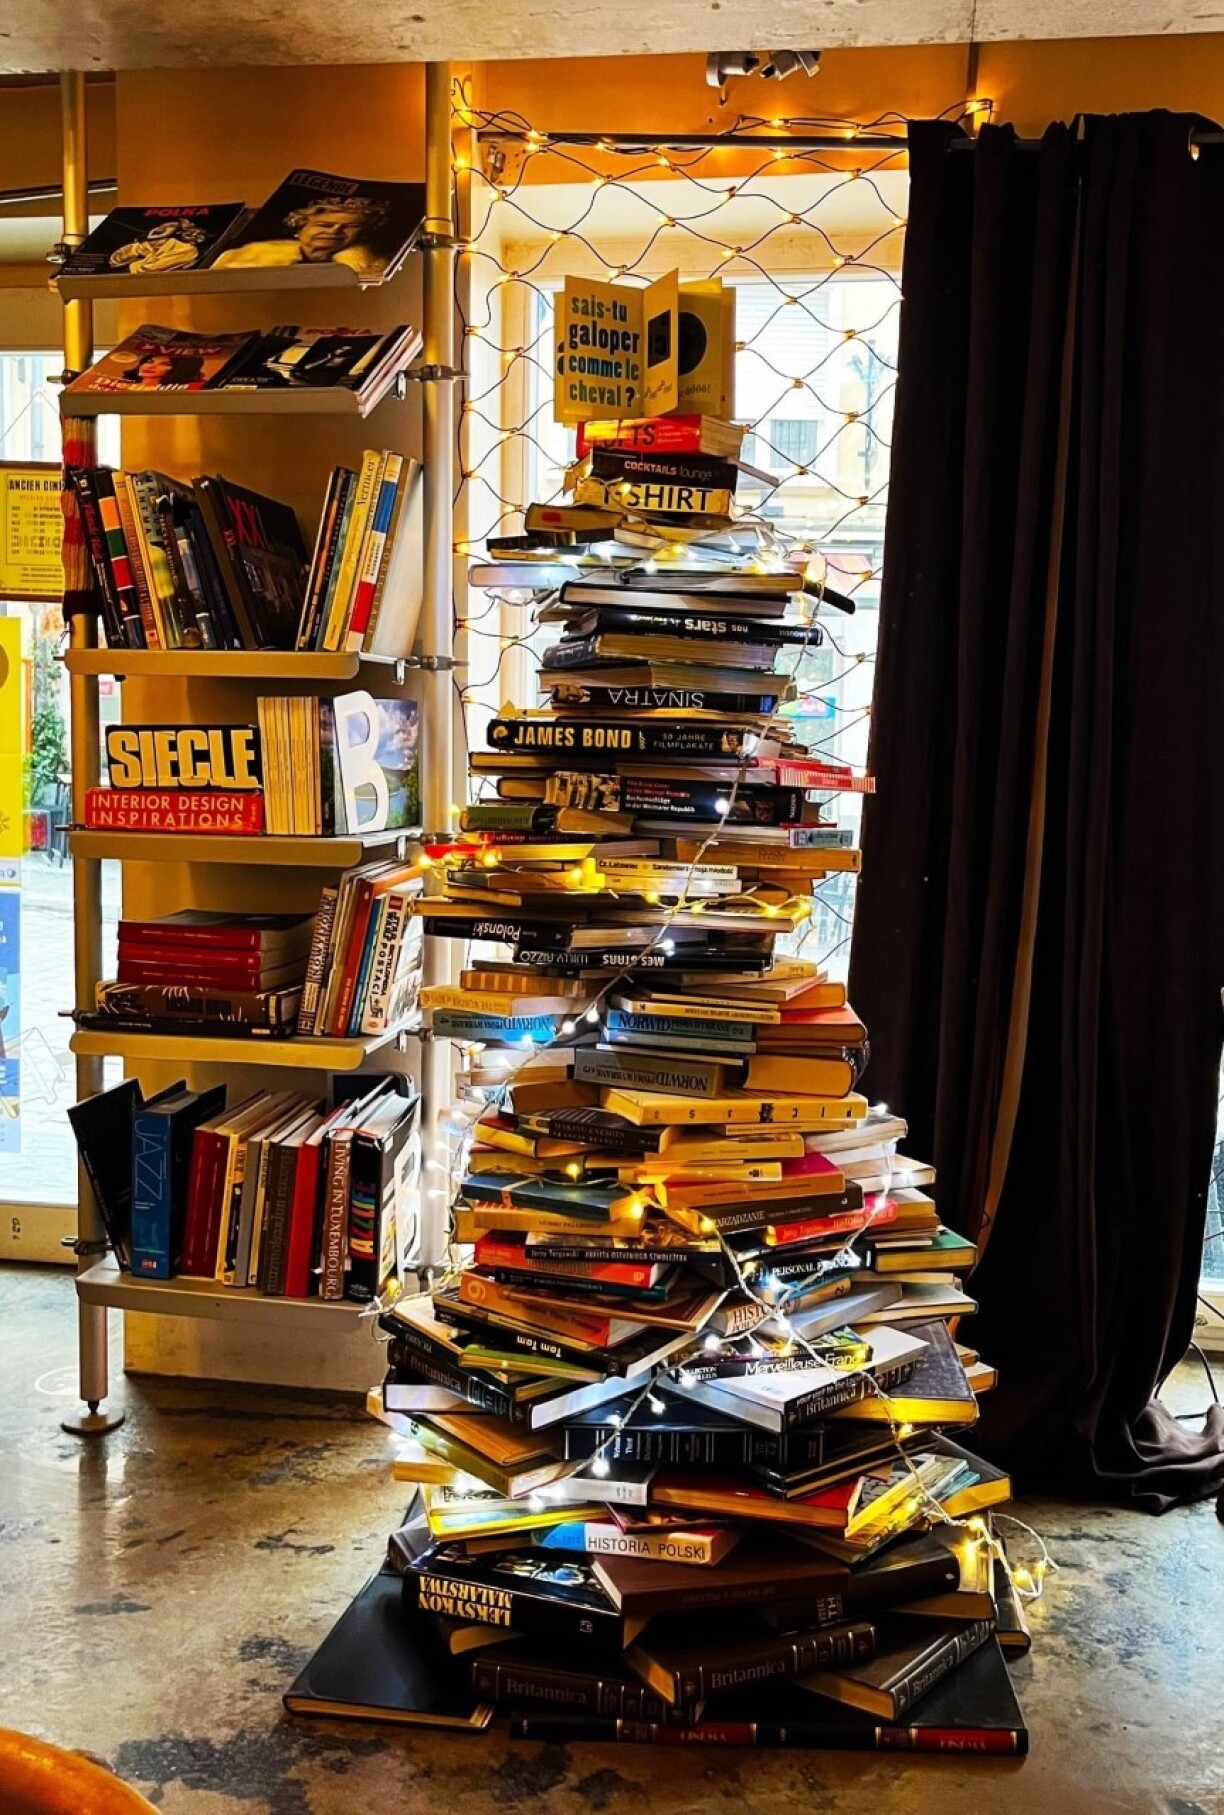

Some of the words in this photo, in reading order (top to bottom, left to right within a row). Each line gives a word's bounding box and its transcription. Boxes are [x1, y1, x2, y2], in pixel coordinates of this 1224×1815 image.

[571, 295, 628, 323] sais-tu
[569, 321, 640, 355] galoper
[569, 354, 622, 378] comme
[625, 358, 640, 381] le
[569, 380, 621, 408] cheval
[357, 458, 376, 506] Vermeer
[623, 460, 678, 477] COCKTAILS
[679, 465, 713, 483] lounge
[9, 479, 41, 491] ANCIEN
[684, 616, 728, 635] stars
[730, 624, 749, 633] nos
[608, 689, 704, 709] SINATRA
[514, 726, 576, 748] JAMES
[582, 728, 632, 749] BOND
[653, 741, 714, 750] FILMPLAKATE
[674, 733, 706, 742] JAHRE
[108, 730, 259, 788] SIECLE
[92, 794, 170, 809] INTERIOR
[178, 796, 244, 811] DESIGN
[92, 811, 243, 826] INSPIRATIONS
[472, 922, 522, 941] Polanski
[370, 942, 387, 995] POSTACI
[520, 951, 554, 964] RIZZO
[640, 956, 665, 968] MES
[503, 1016, 551, 1031] NORWID
[617, 1013, 671, 1032] NORWID
[655, 1072, 709, 1092] NORWID
[134, 1118, 163, 1200] JAZZ
[333, 1142, 348, 1191] LIVING
[332, 1191, 343, 1209] IN
[324, 1205, 343, 1299] LUXEMBOURG
[772, 1262, 815, 1276] PERSONAL
[410, 1353, 463, 1391] Britannica
[745, 1356, 821, 1376] Merveilleuse
[588, 1537, 651, 1555] HISTORIA
[658, 1543, 707, 1561] POLSKI
[419, 1576, 513, 1608] MALARSTWA
[417, 1591, 512, 1627] LEKSYKON
[710, 1658, 786, 1689] Britannica
[912, 1654, 955, 1696] Britannica
[506, 1678, 588, 1705] Britannica
